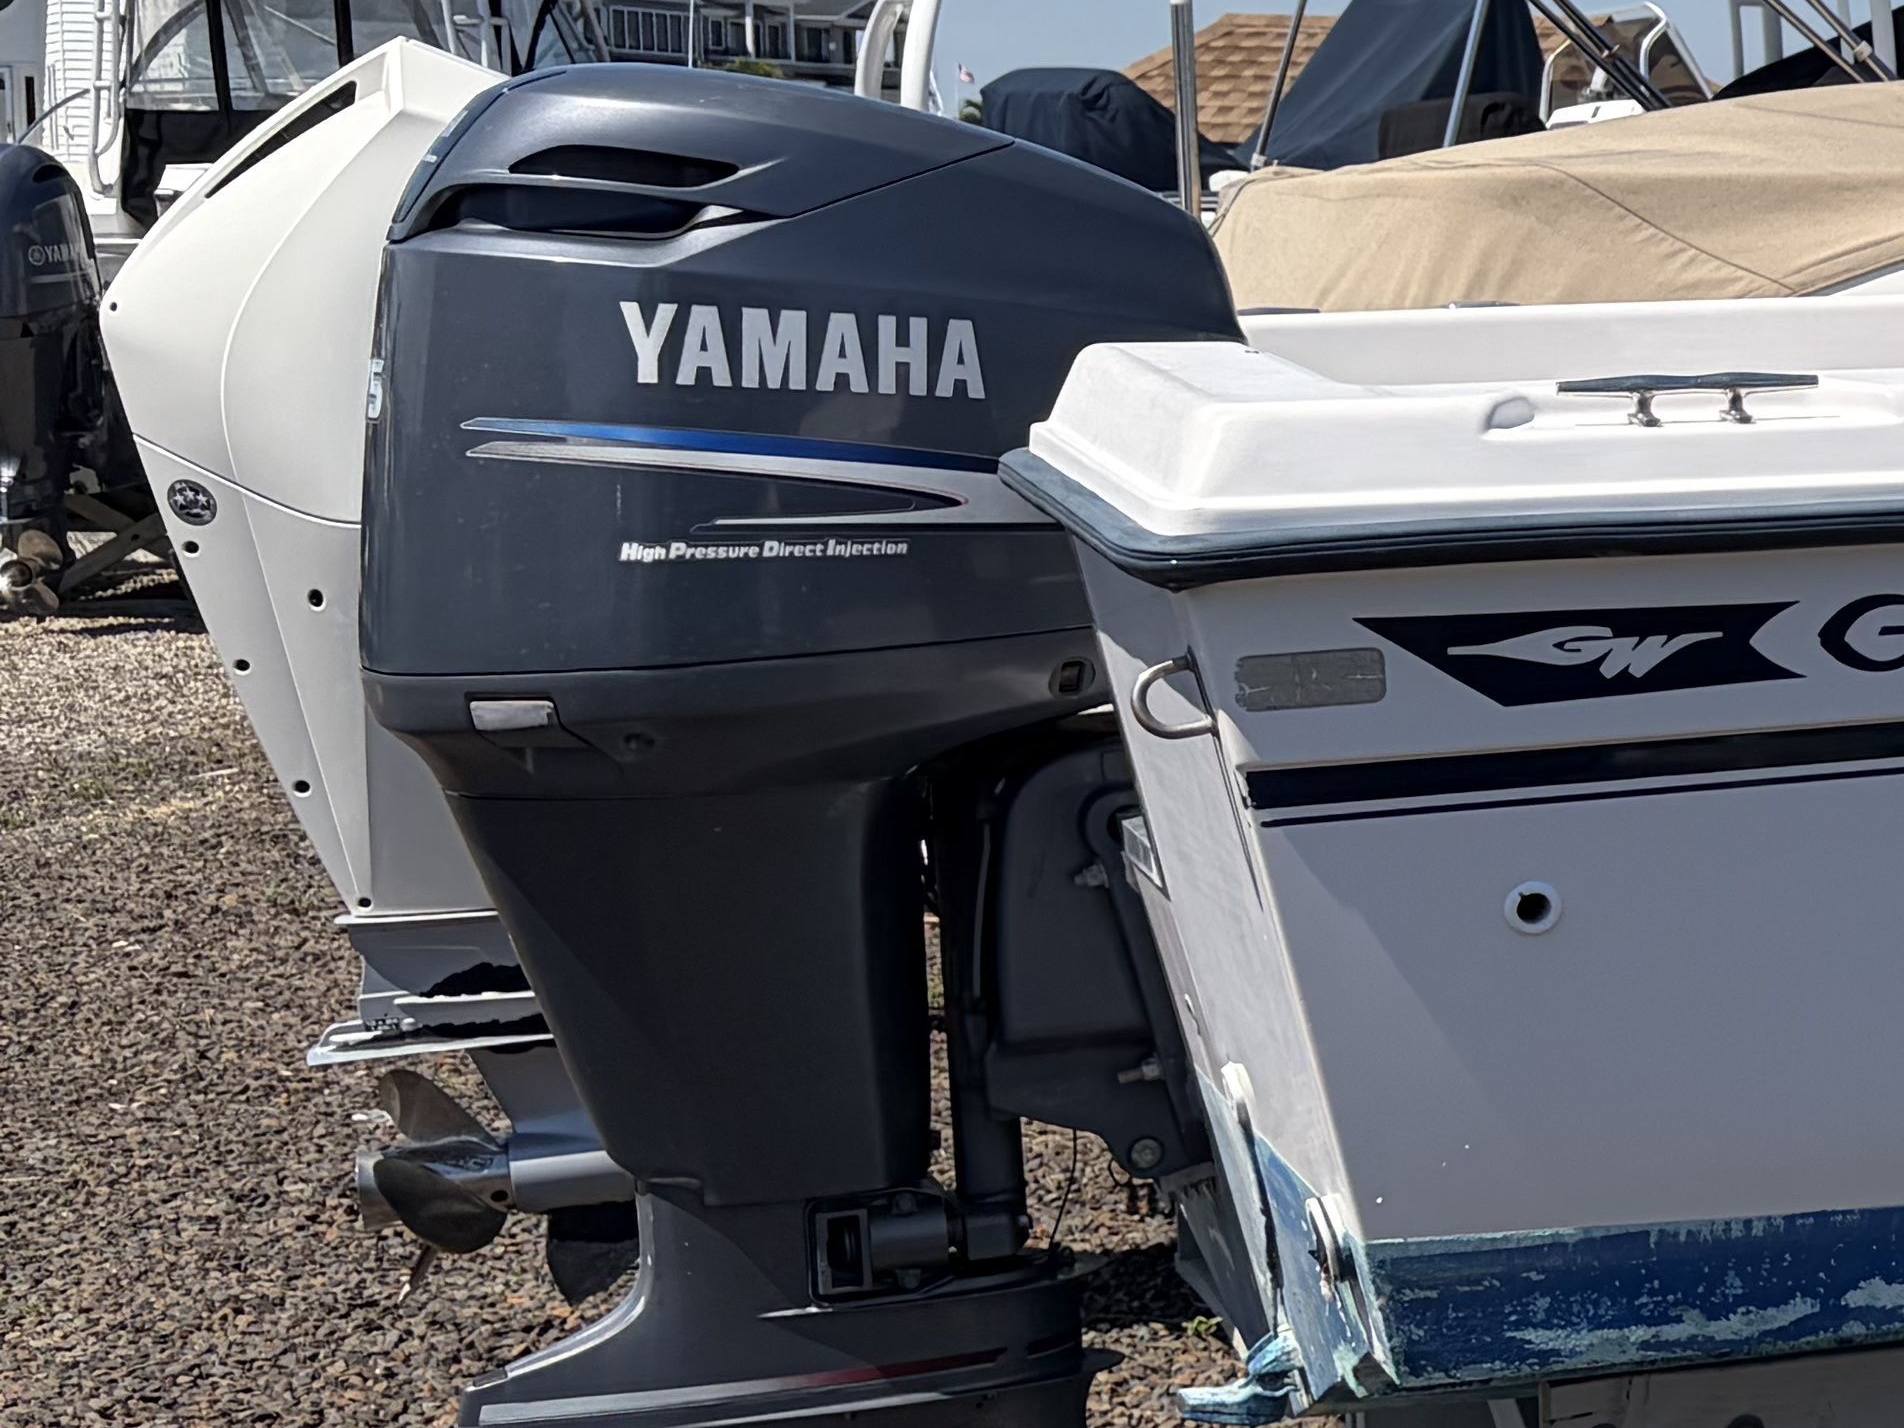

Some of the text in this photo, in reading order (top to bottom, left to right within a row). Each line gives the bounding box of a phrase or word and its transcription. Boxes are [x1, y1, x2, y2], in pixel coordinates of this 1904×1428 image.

[619, 301, 986, 399] YAMAHA
[619, 538, 908, 563] High Pressure Direct Injection
